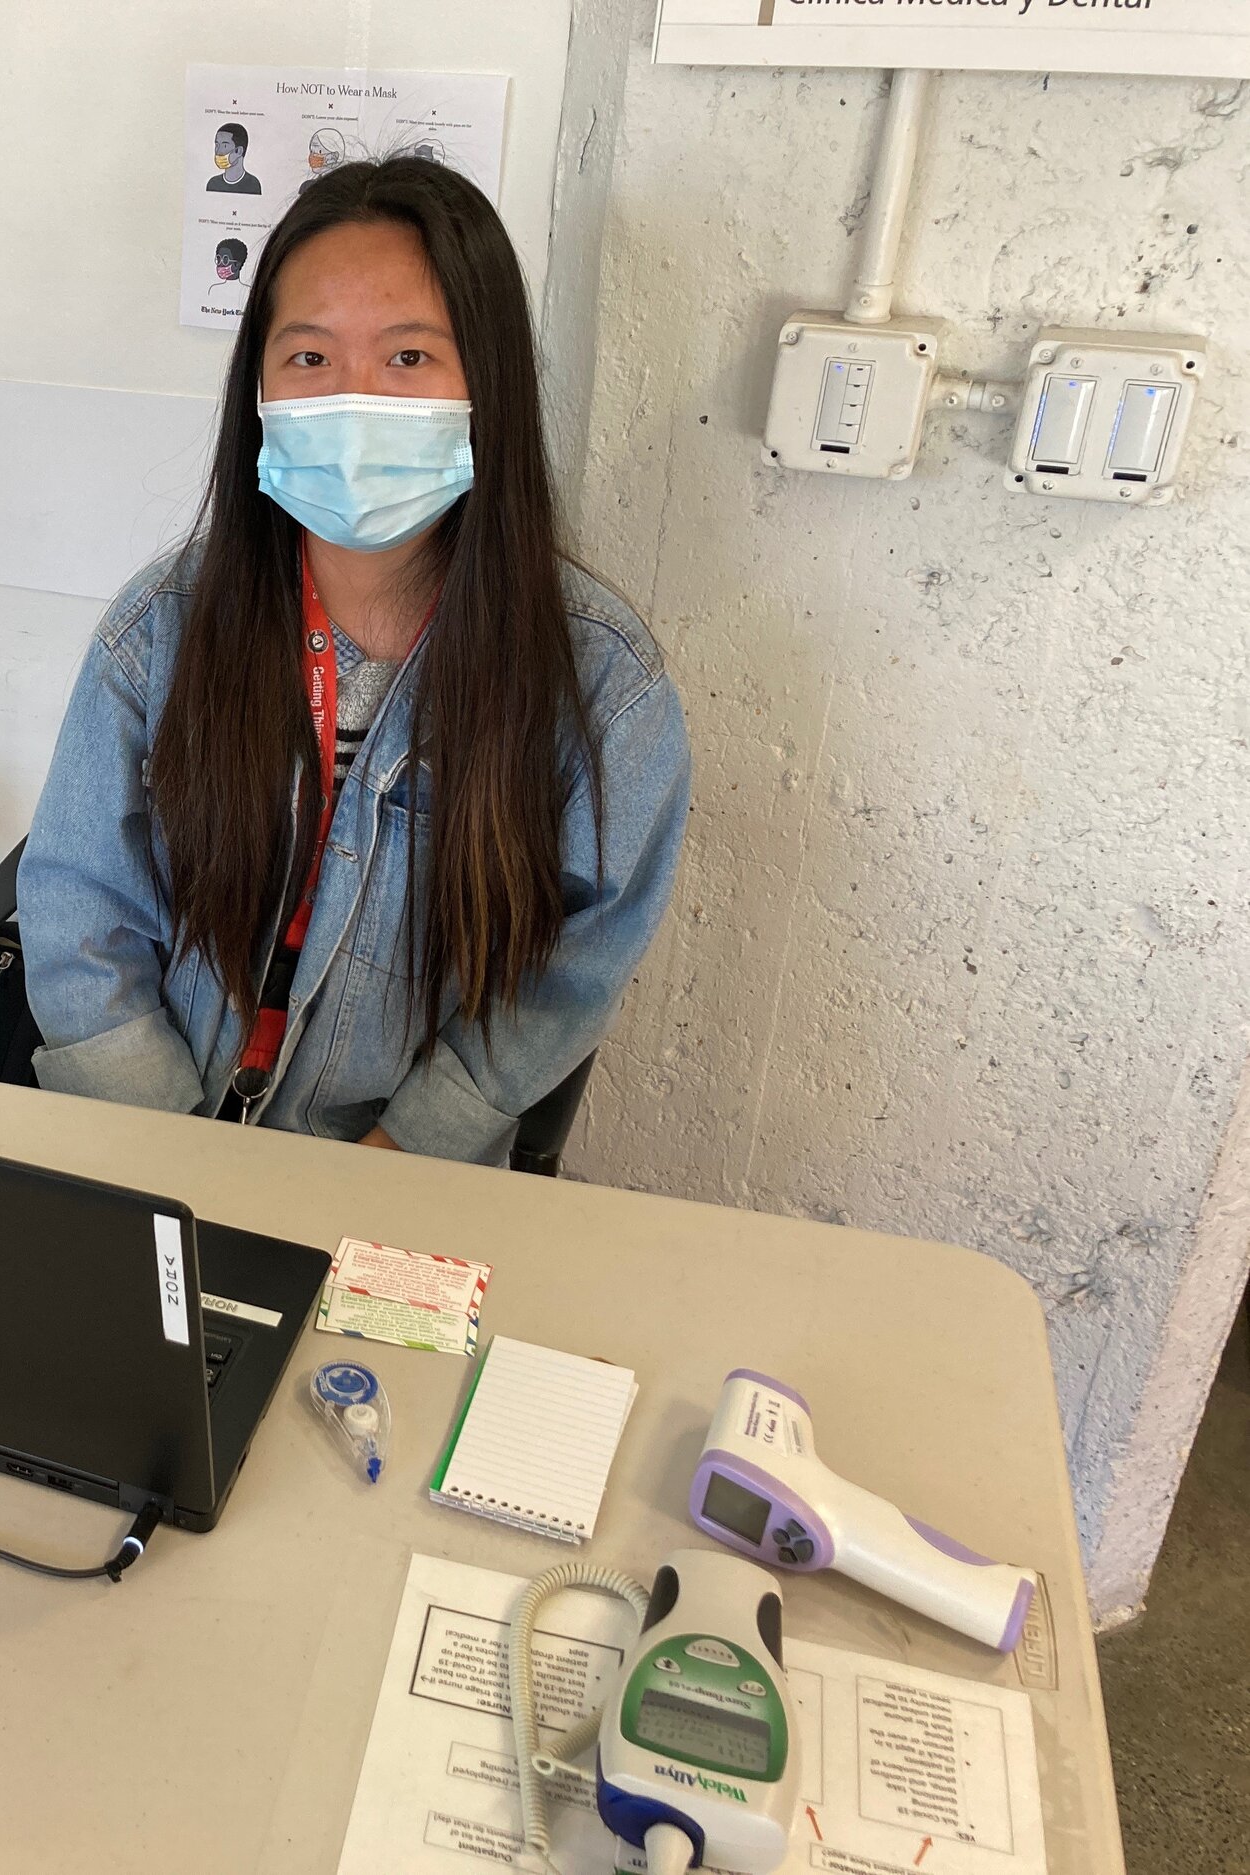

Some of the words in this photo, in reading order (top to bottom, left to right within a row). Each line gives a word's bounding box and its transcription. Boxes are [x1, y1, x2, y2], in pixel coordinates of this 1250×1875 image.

[276, 82, 299, 94] How
[300, 83, 325, 95] NOT
[326, 86, 335, 96] to
[337, 85, 363, 97] Wear
[364, 89, 370, 97] a
[372, 86, 398, 99] Mask
[311, 666, 325, 707] Getting
[164, 1254, 179, 1306] NORA
[444, 1628, 477, 1643] medical
[440, 1645, 452, 1654] up
[459, 1642, 472, 1651] for
[488, 1639, 500, 1648] for
[454, 1651, 484, 1664] looked
[474, 1645, 499, 1657] notes
[567, 1647, 589, 1659] appt
[437, 1657, 477, 1673] Covid-19
[485, 1658, 497, 1667] be
[555, 1654, 587, 1668] patient
[430, 1666, 453, 1677] basic
[535, 1671, 565, 1683] results
[437, 1678, 462, 1689] nurse
[468, 1674, 504, 1689] positive
[566, 1678, 585, 1688] test
[464, 1684, 490, 1696] triage
[542, 1682, 583, 1698] Covid-19
[476, 1698, 511, 1712] Nurse:
[542, 1691, 575, 1706] patient
[458, 1841, 512, 1863] Outpatient
